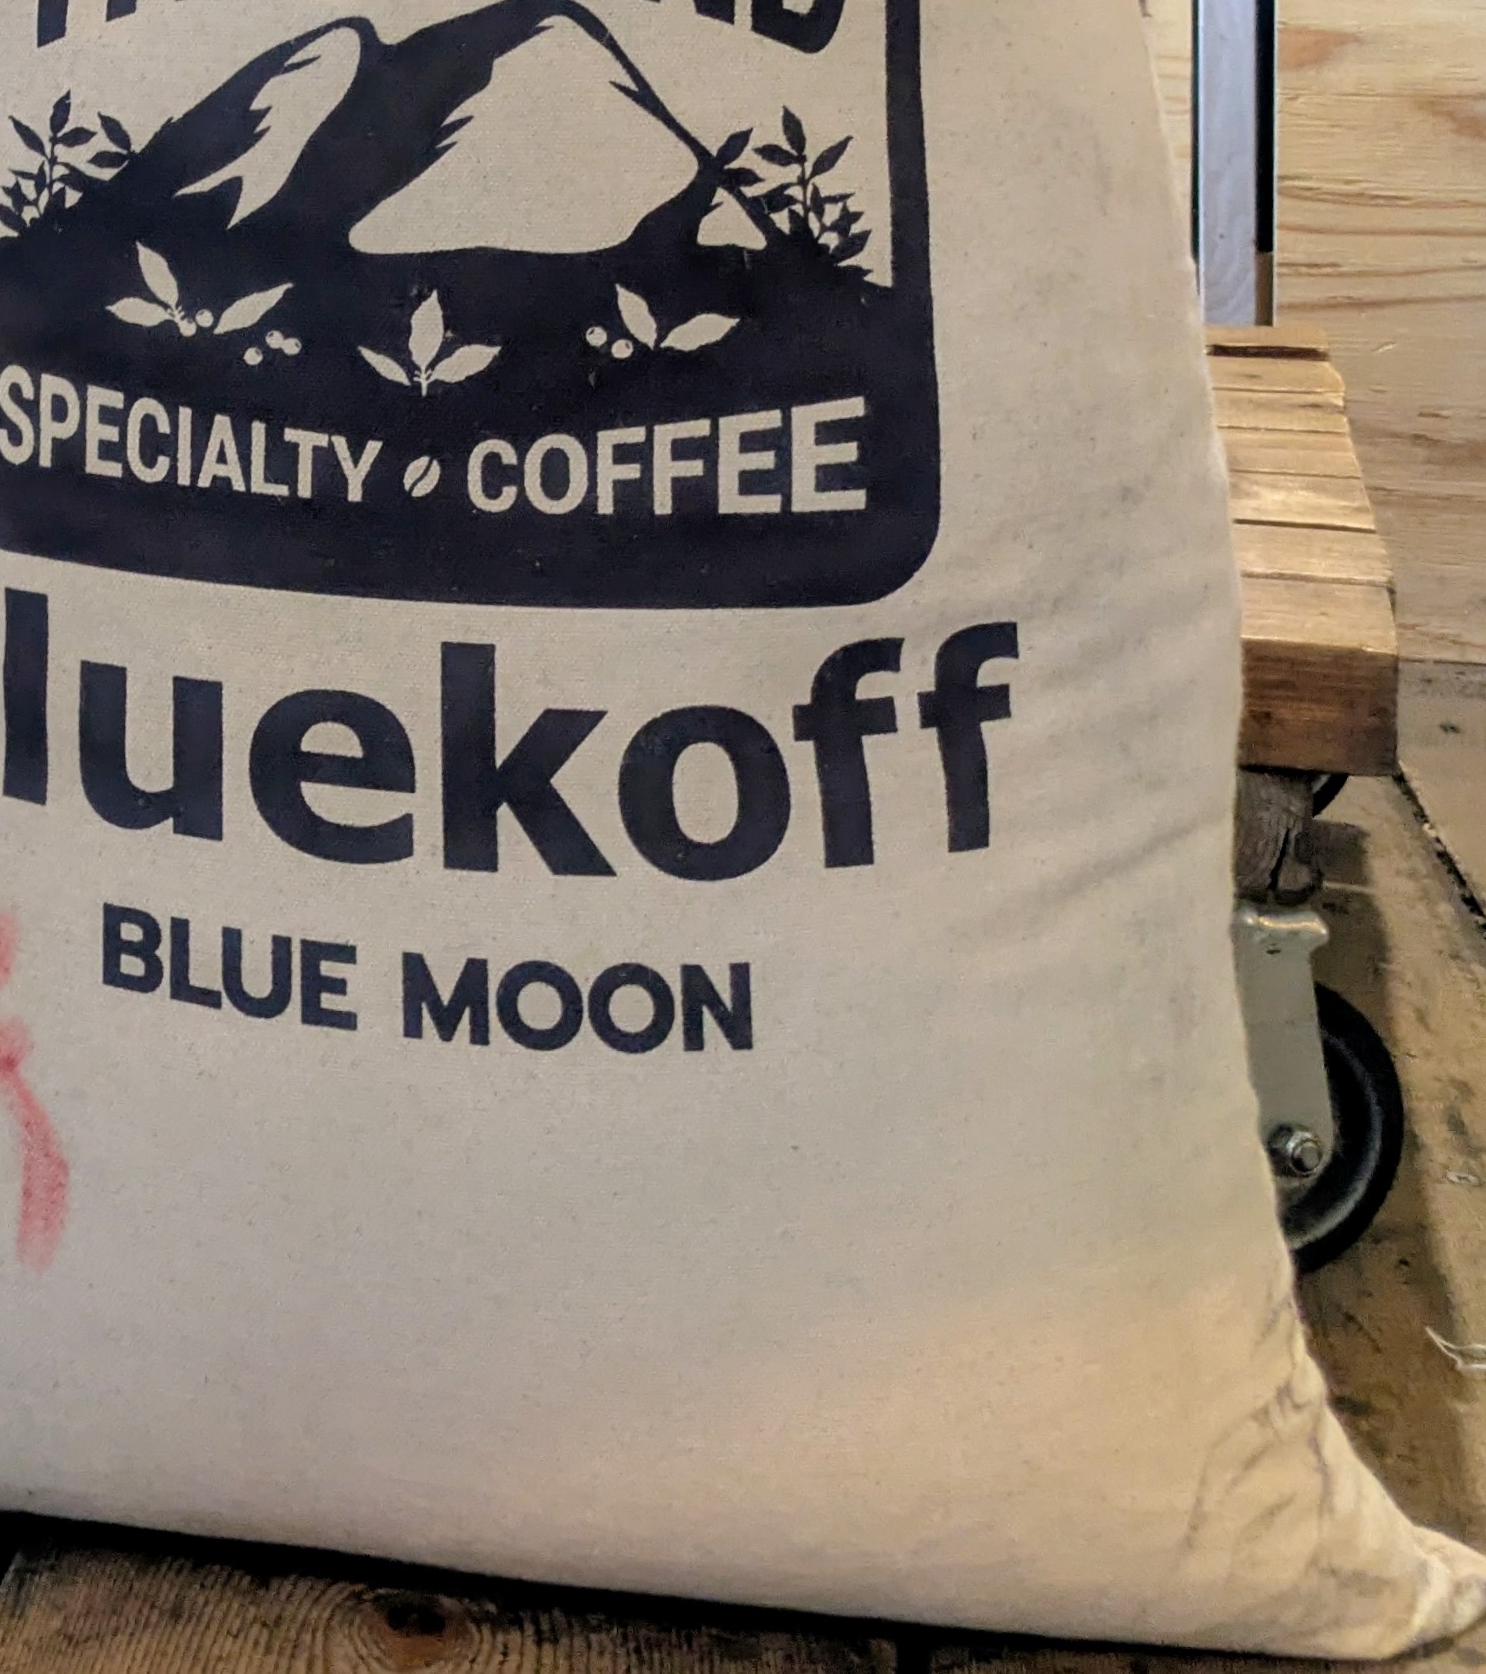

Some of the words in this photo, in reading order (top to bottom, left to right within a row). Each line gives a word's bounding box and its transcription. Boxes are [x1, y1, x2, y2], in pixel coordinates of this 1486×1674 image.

[466, 395, 868, 516] COFFEE
[101, 901, 359, 1032] BLUE
[401, 950, 755, 1056] MOON
